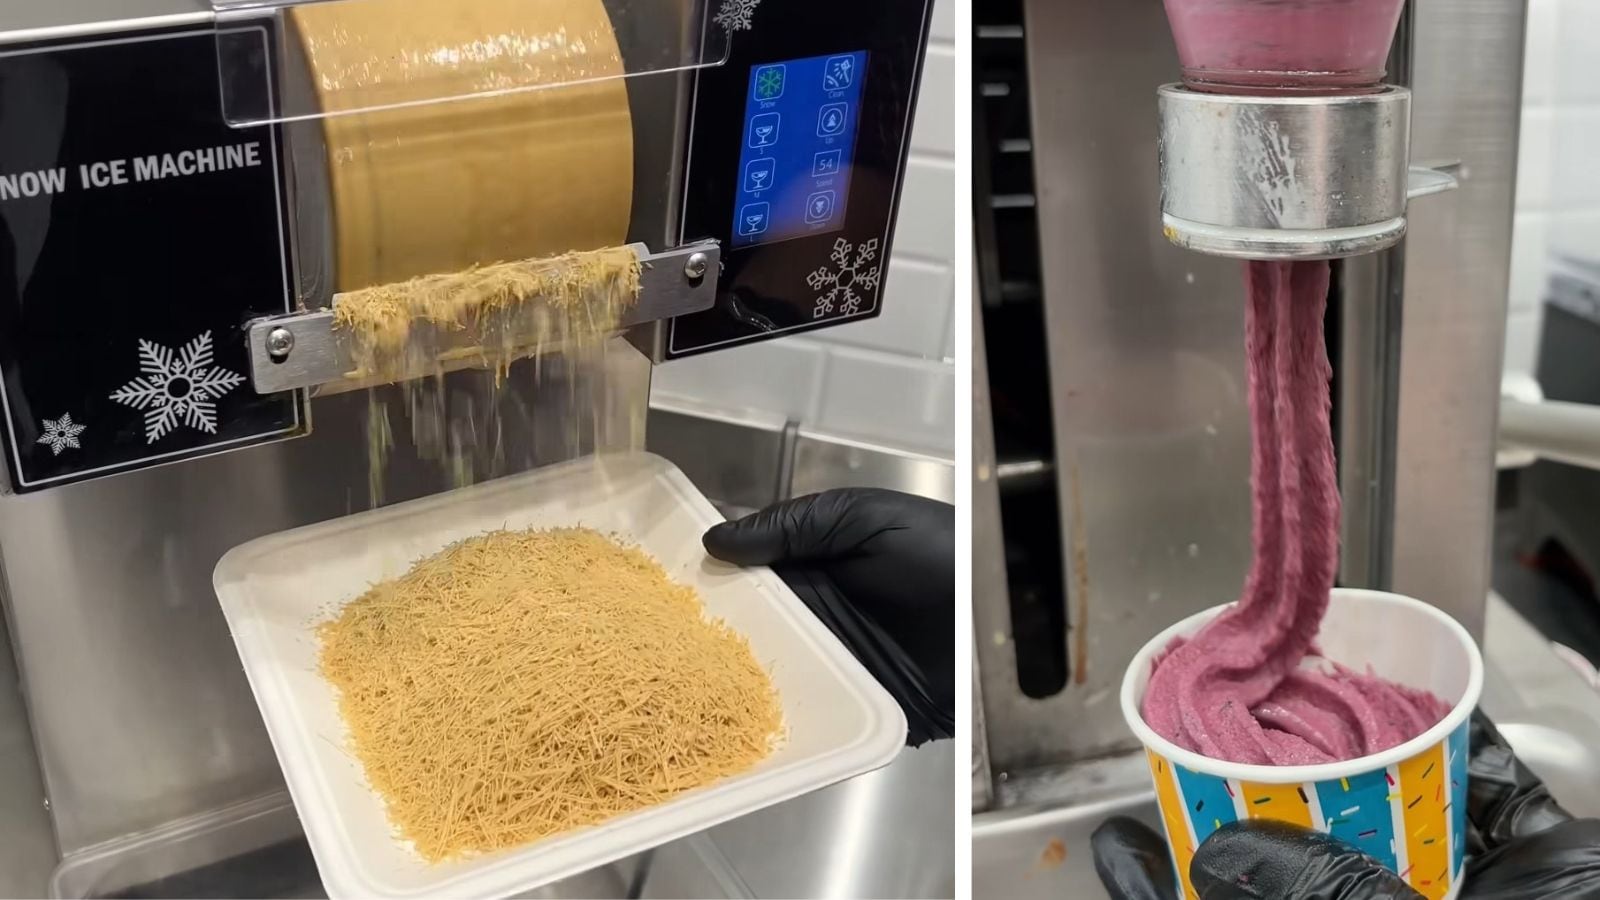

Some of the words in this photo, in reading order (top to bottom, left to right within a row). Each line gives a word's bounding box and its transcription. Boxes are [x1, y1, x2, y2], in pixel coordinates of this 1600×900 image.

[79, 159, 129, 189] ICE
[133, 142, 262, 182] MACHINE
[818, 158, 833, 171] 54
